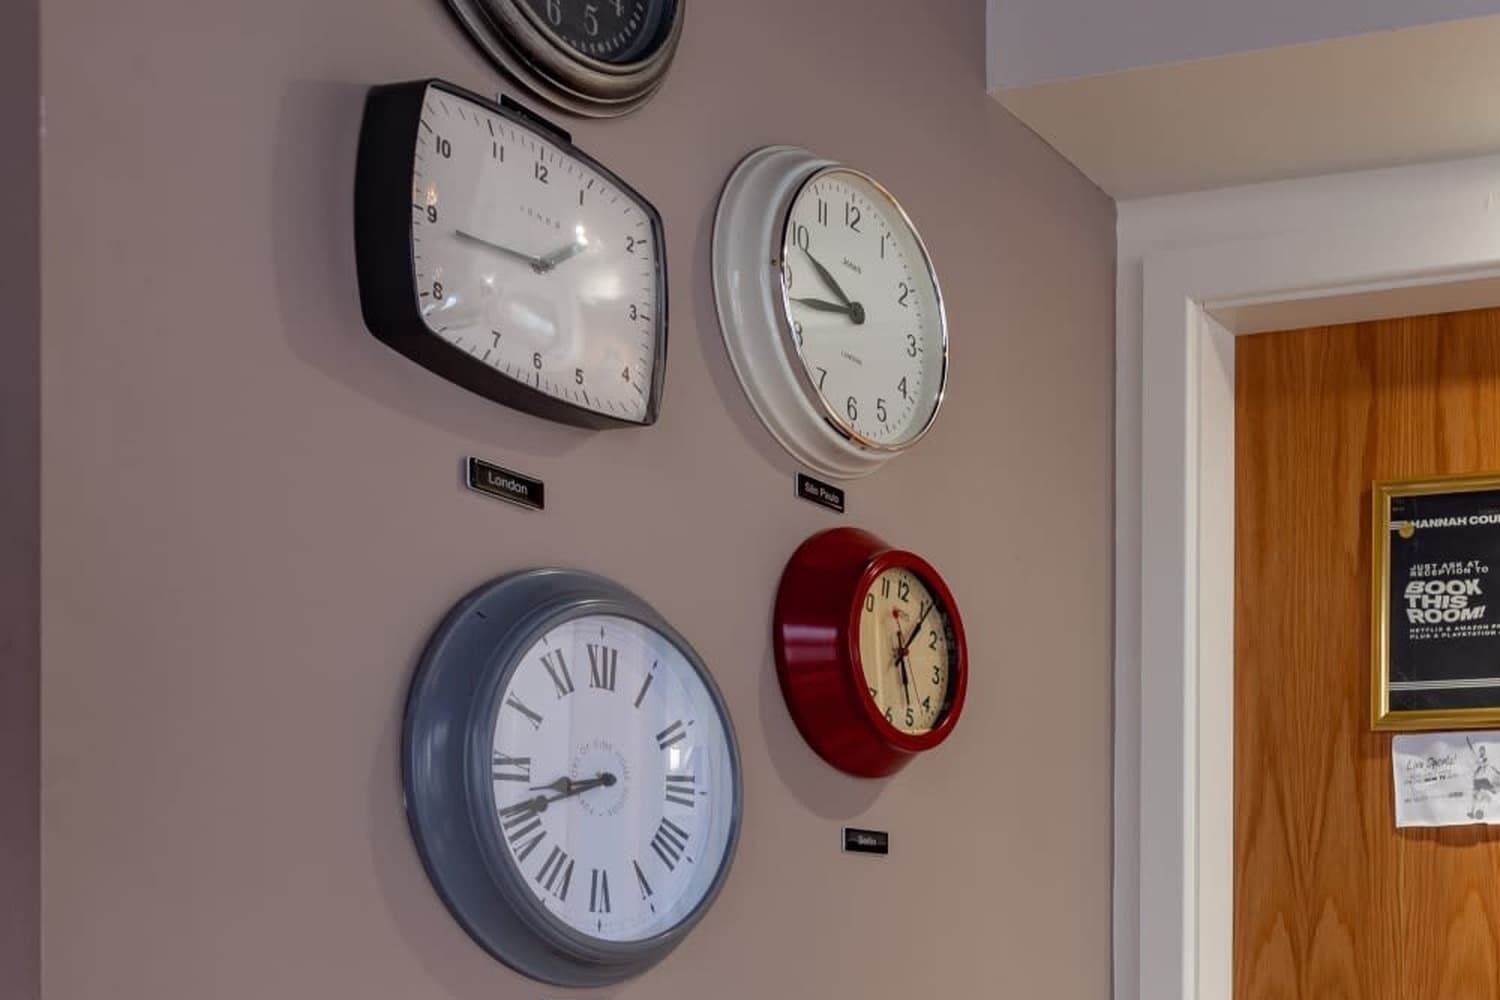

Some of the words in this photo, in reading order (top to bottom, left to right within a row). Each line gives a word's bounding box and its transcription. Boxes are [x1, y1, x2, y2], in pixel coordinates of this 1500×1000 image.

[584, 3, 599, 37] 5
[435, 135, 452, 159] 10
[492, 141, 504, 163] 11
[534, 162, 549, 184] 12
[427, 205, 438, 223] 9
[818, 198, 828, 227] 11
[845, 201, 861, 234] 12
[626, 236, 635, 253] 2
[792, 220, 809, 252] 10
[432, 282, 443, 300] 8
[898, 282, 909, 308] 2
[628, 304, 638, 321] 3
[491, 330, 501, 348] 7
[907, 334, 917, 358] 3
[533, 352, 543, 370] 6
[575, 368, 585, 384] 5
[621, 366, 631, 383] 4
[816, 366, 827, 390] 7
[898, 377, 907, 400] 4
[847, 396, 858, 421] 6
[877, 398, 888, 423] 5
[488, 470, 529, 496] London
[1410, 516, 1467, 529] HANNAH
[1410, 563, 1437, 571] JUST
[1442, 561, 1462, 569] ASK
[1410, 567, 1471, 577] RECEPTION
[1475, 566, 1489, 574] TO
[881, 577, 891, 599] 11
[897, 579, 911, 602] 12
[1405, 578, 1483, 596] BOOK
[1403, 594, 1469, 609] THIS
[1406, 605, 1487, 624] ROOM!
[929, 631, 937, 650] 2
[587, 643, 617, 692] XII
[931, 665, 940, 684] 3
[922, 696, 931, 713] 4
[905, 708, 915, 727] 5
